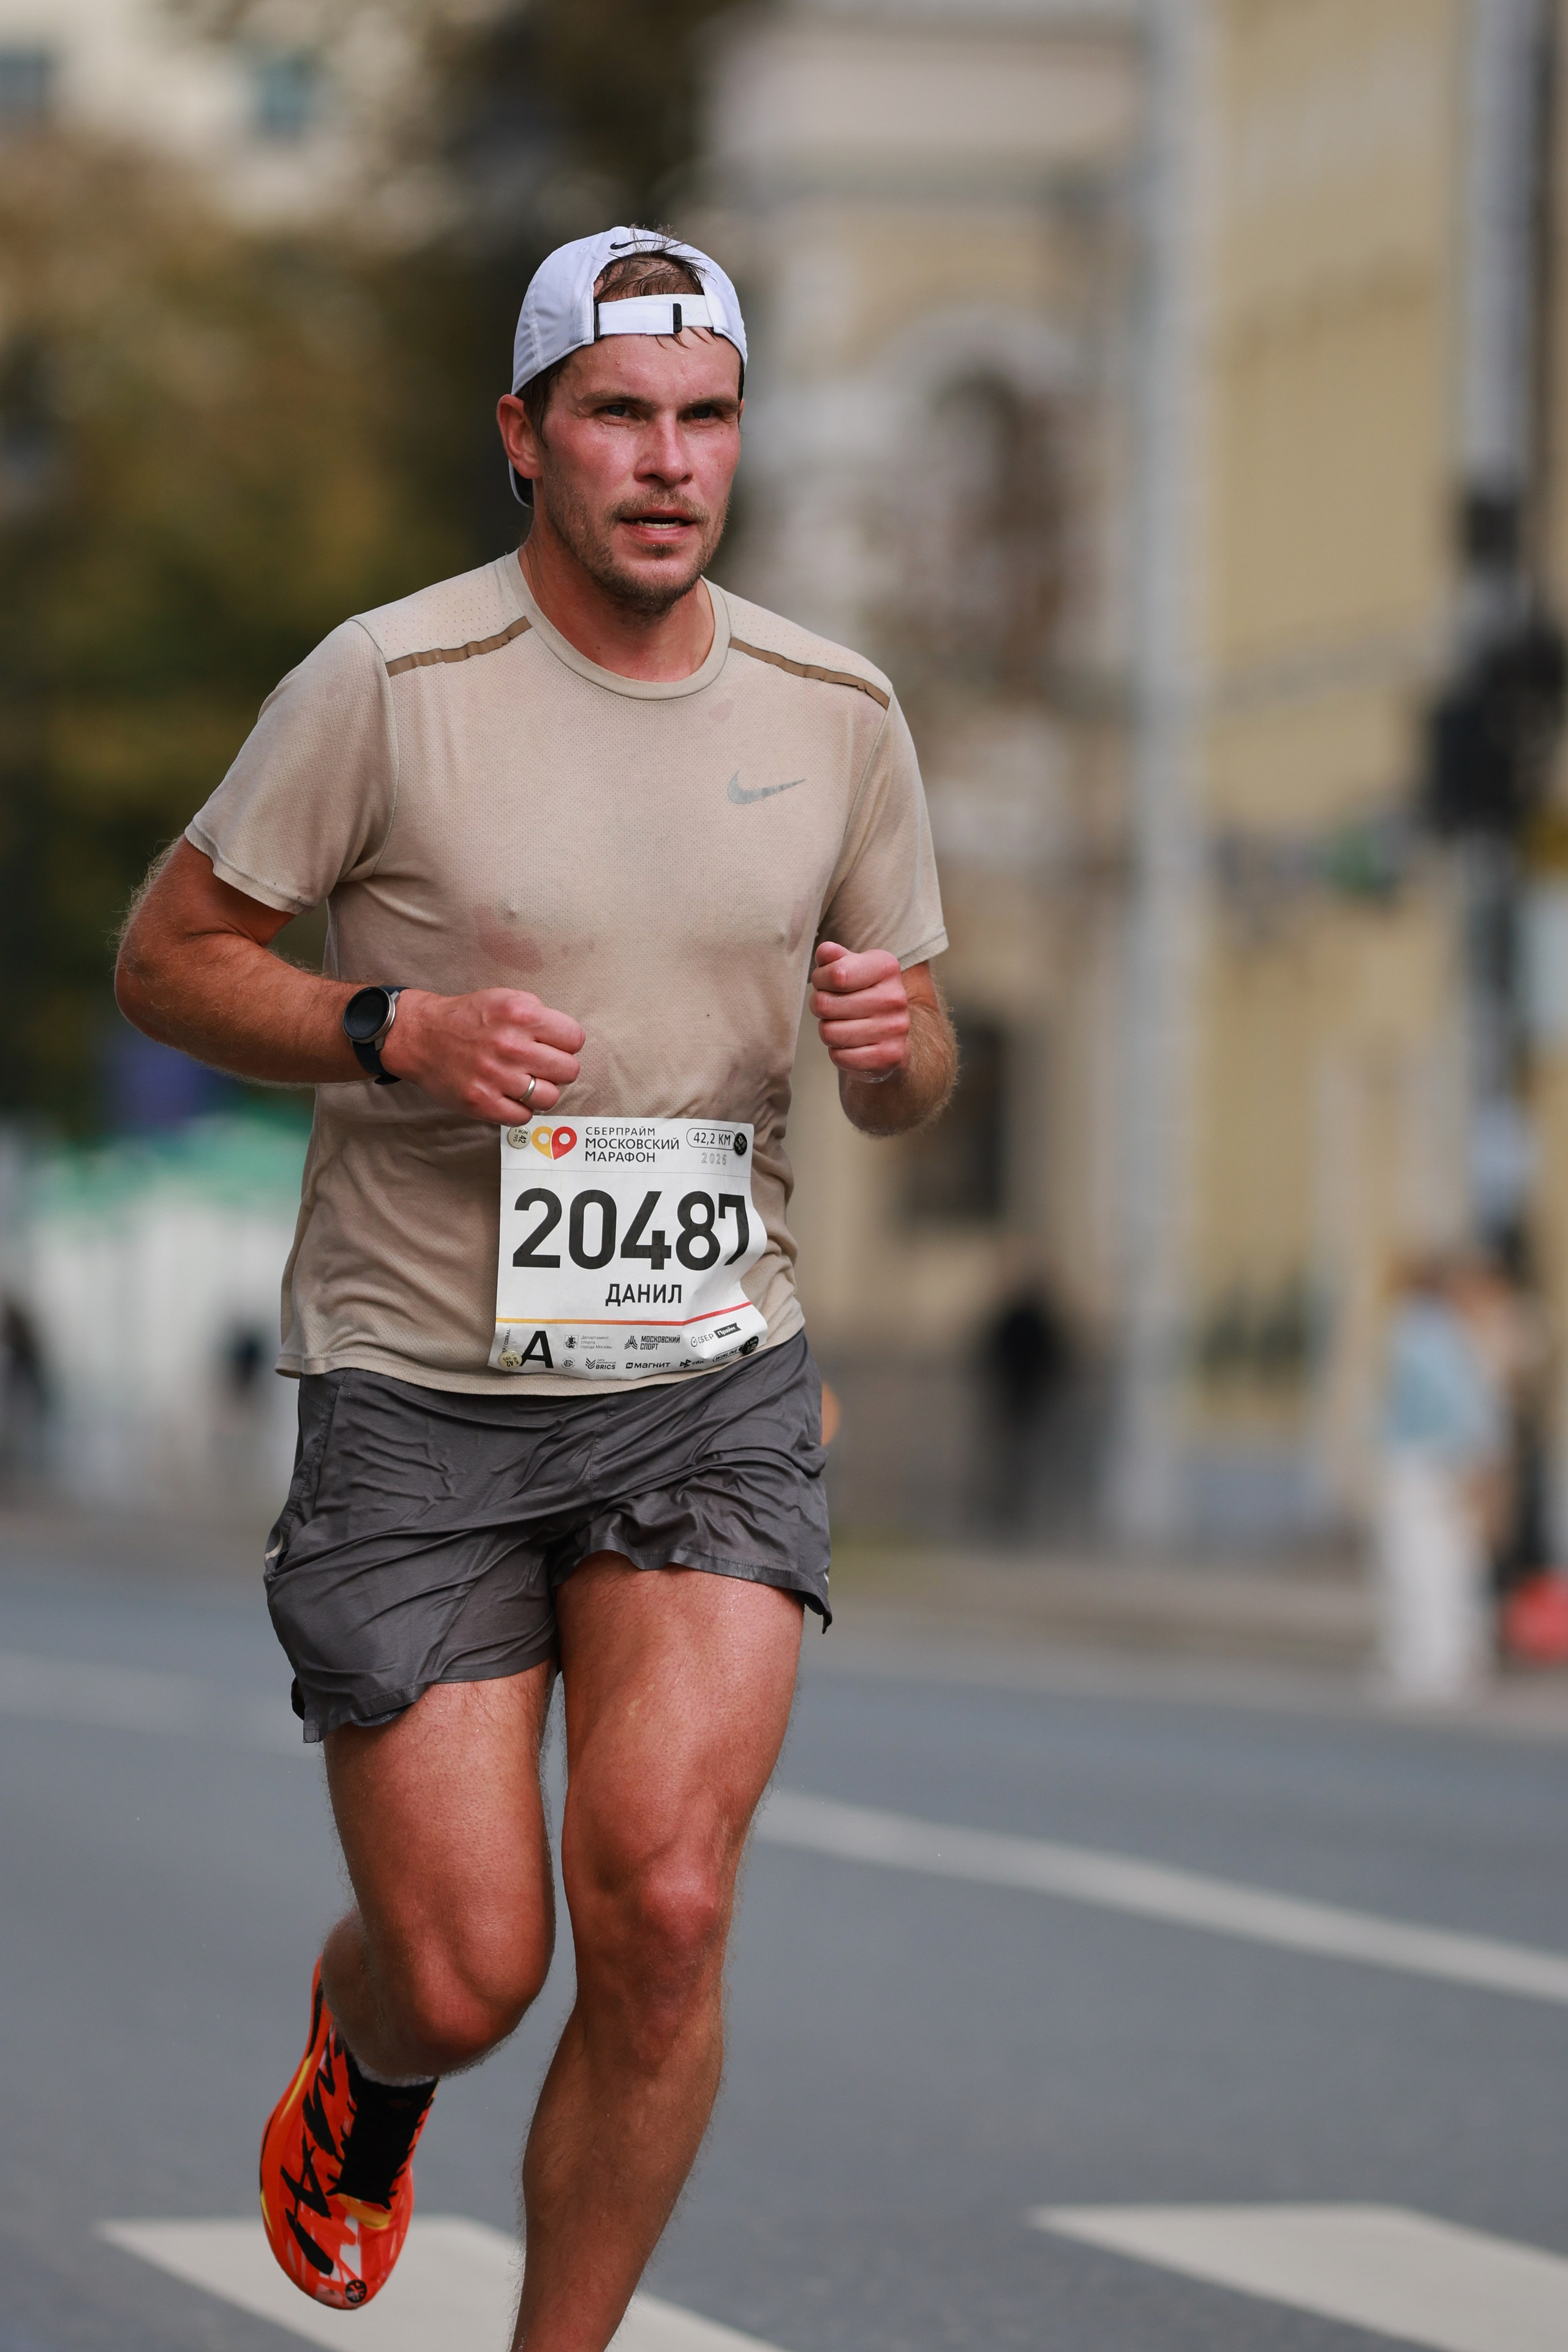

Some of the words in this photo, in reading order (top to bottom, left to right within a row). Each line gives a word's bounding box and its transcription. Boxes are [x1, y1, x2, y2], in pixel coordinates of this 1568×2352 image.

[586, 1126, 655, 1136] СБЕРПРАЙМ
[518, 1135, 527, 1144] 42
[585, 1137, 679, 1150] МОСКОВСКИЙ
[693, 1132, 715, 1145] 42,2
[585, 1151, 655, 1163] МАРАФОН
[512, 1188, 750, 1271] 20487
[605, 1283, 682, 1307] ДАНИЛ
[698, 1333, 714, 1344] СБЕР
[717, 1325, 736, 1335] Прайм
[715, 1348, 738, 1360] WINLINE
